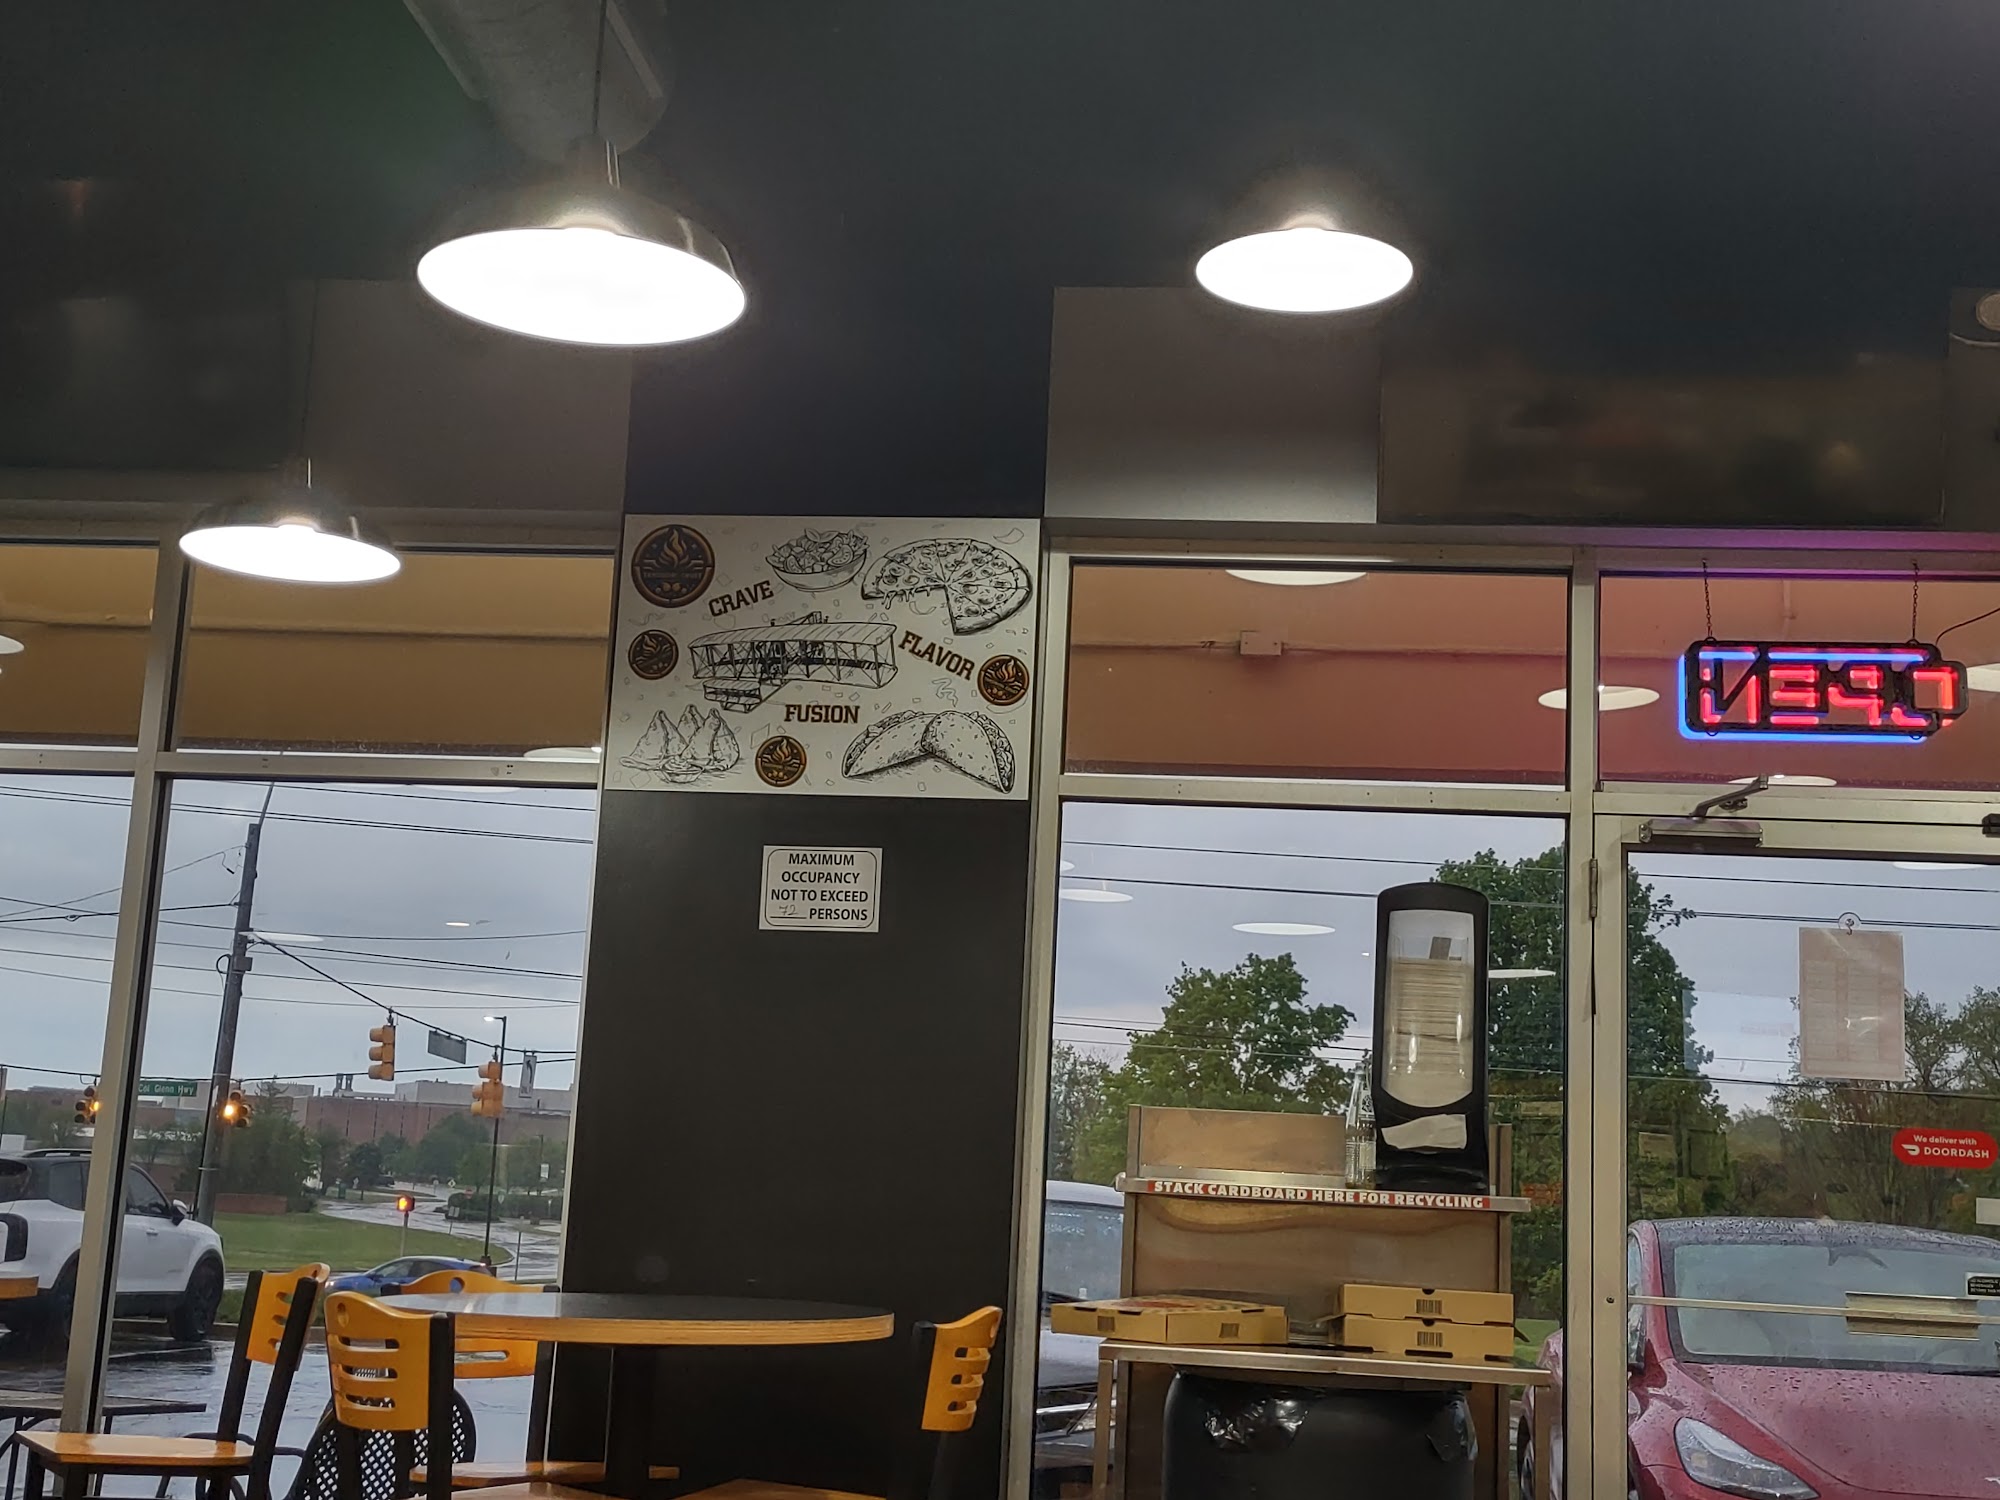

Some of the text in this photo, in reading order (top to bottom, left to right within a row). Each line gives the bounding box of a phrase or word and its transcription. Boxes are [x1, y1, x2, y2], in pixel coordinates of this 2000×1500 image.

[708, 580, 774, 617] CRAVE
[898, 630, 975, 681] FLAVOR
[784, 704, 860, 724] FUSION
[788, 853, 855, 866] MAXIMUM
[781, 871, 861, 884] OCCUPANCY
[771, 889, 869, 902] NOT TO EXCEED
[779, 904, 868, 921] 72 PERSONS
[154, 1084, 175, 1094] Glenn
[177, 1084, 194, 1096] Hwy
[1913, 1134, 1977, 1146] We deliver with
[1923, 1147, 1990, 1159] DOORDASH
[1154, 1181, 1484, 1208] STACK CARDBOARD HERE FOR RECYCLING
